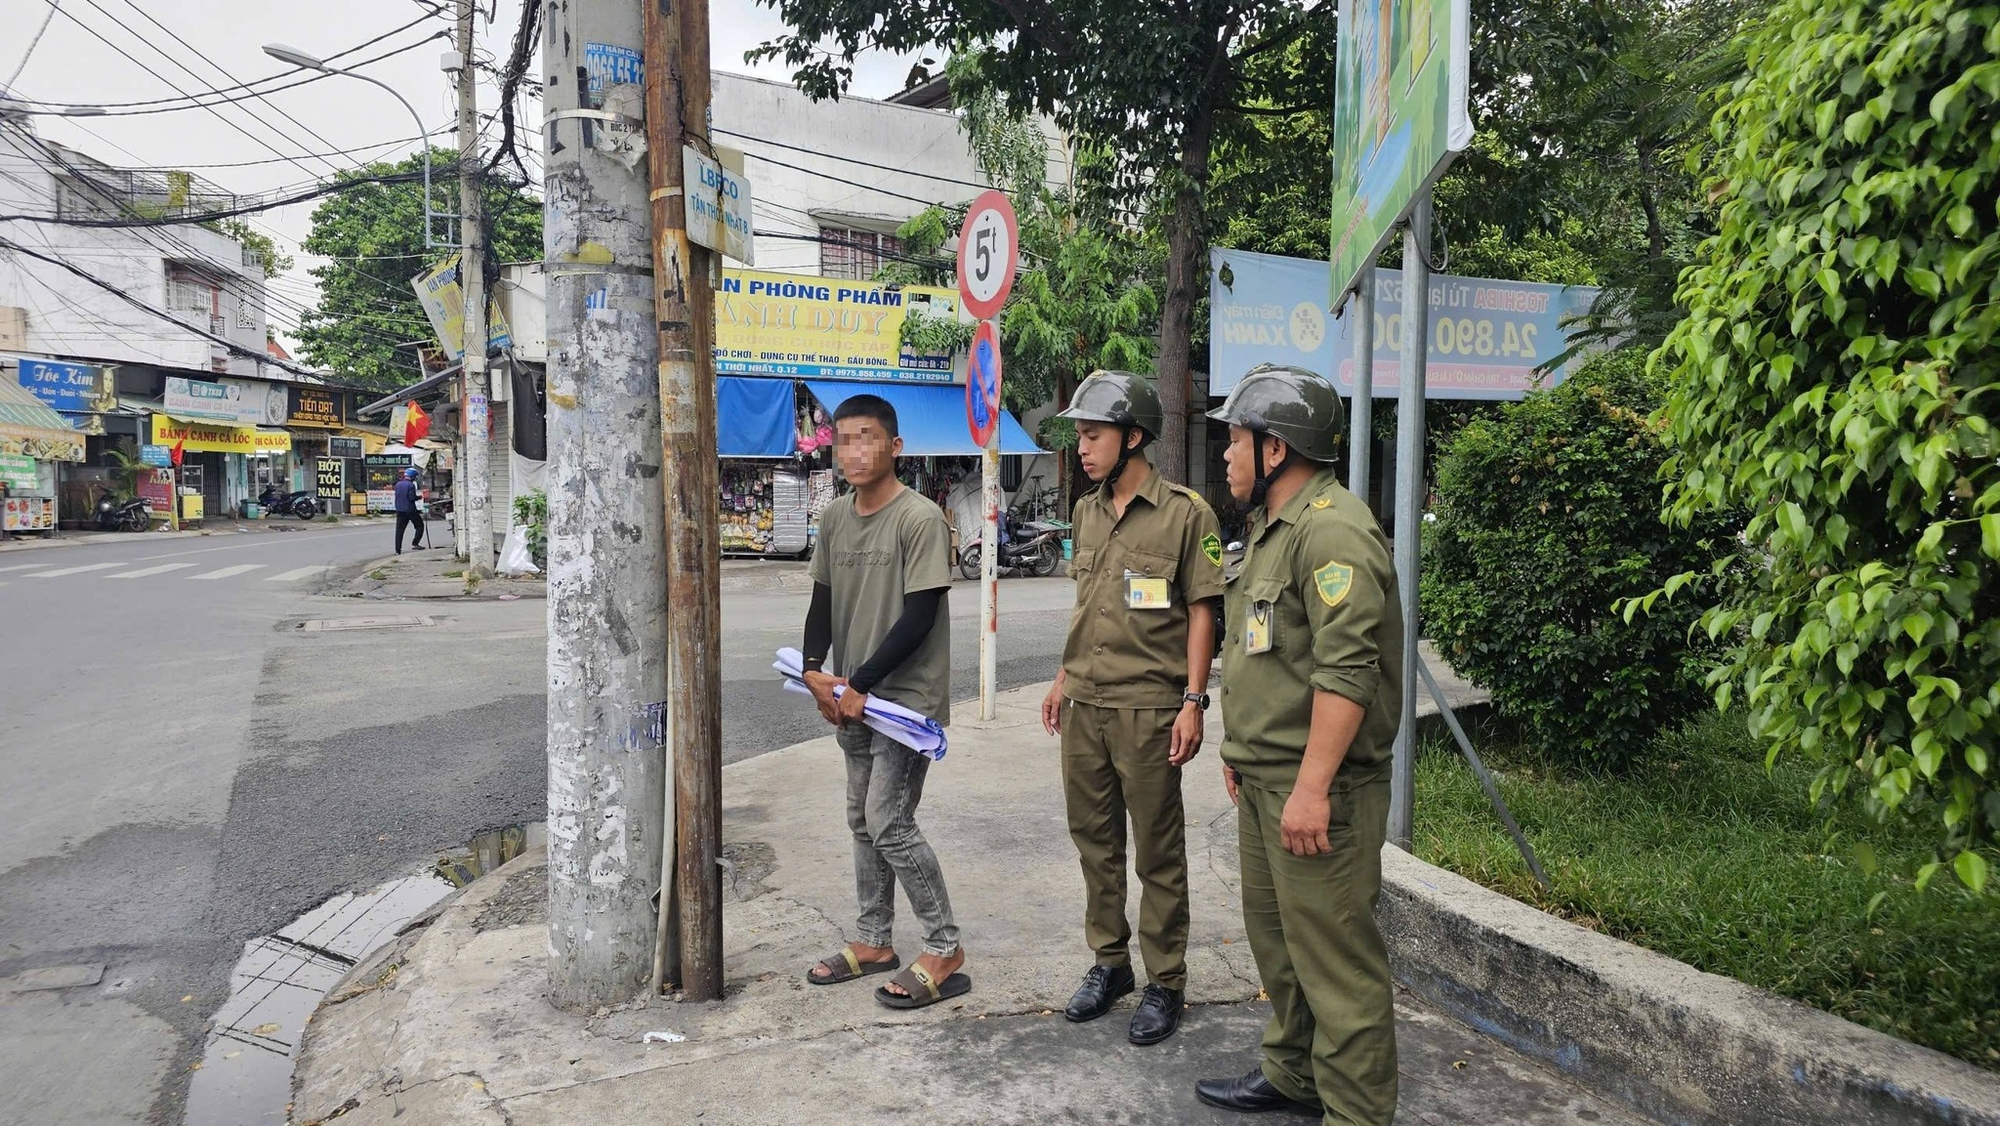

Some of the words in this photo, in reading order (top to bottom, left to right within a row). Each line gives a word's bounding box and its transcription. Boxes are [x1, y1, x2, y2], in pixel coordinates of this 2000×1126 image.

[743, 220, 749, 234] B
[749, 280, 830, 302] PHÒNG
[837, 284, 902, 307] PHẨM
[806, 306, 888, 336] DUY
[730, 349, 752, 359] CHƠI
[818, 355, 840, 365] THAO
[33, 364, 59, 383] Tóc
[62, 366, 94, 386] Kim
[776, 366, 798, 375] Q.12
[190, 430, 217, 443] CANH
[317, 459, 341, 472] HỚT
[317, 472, 341, 485] TÓC
[317, 487, 341, 498] NAM
